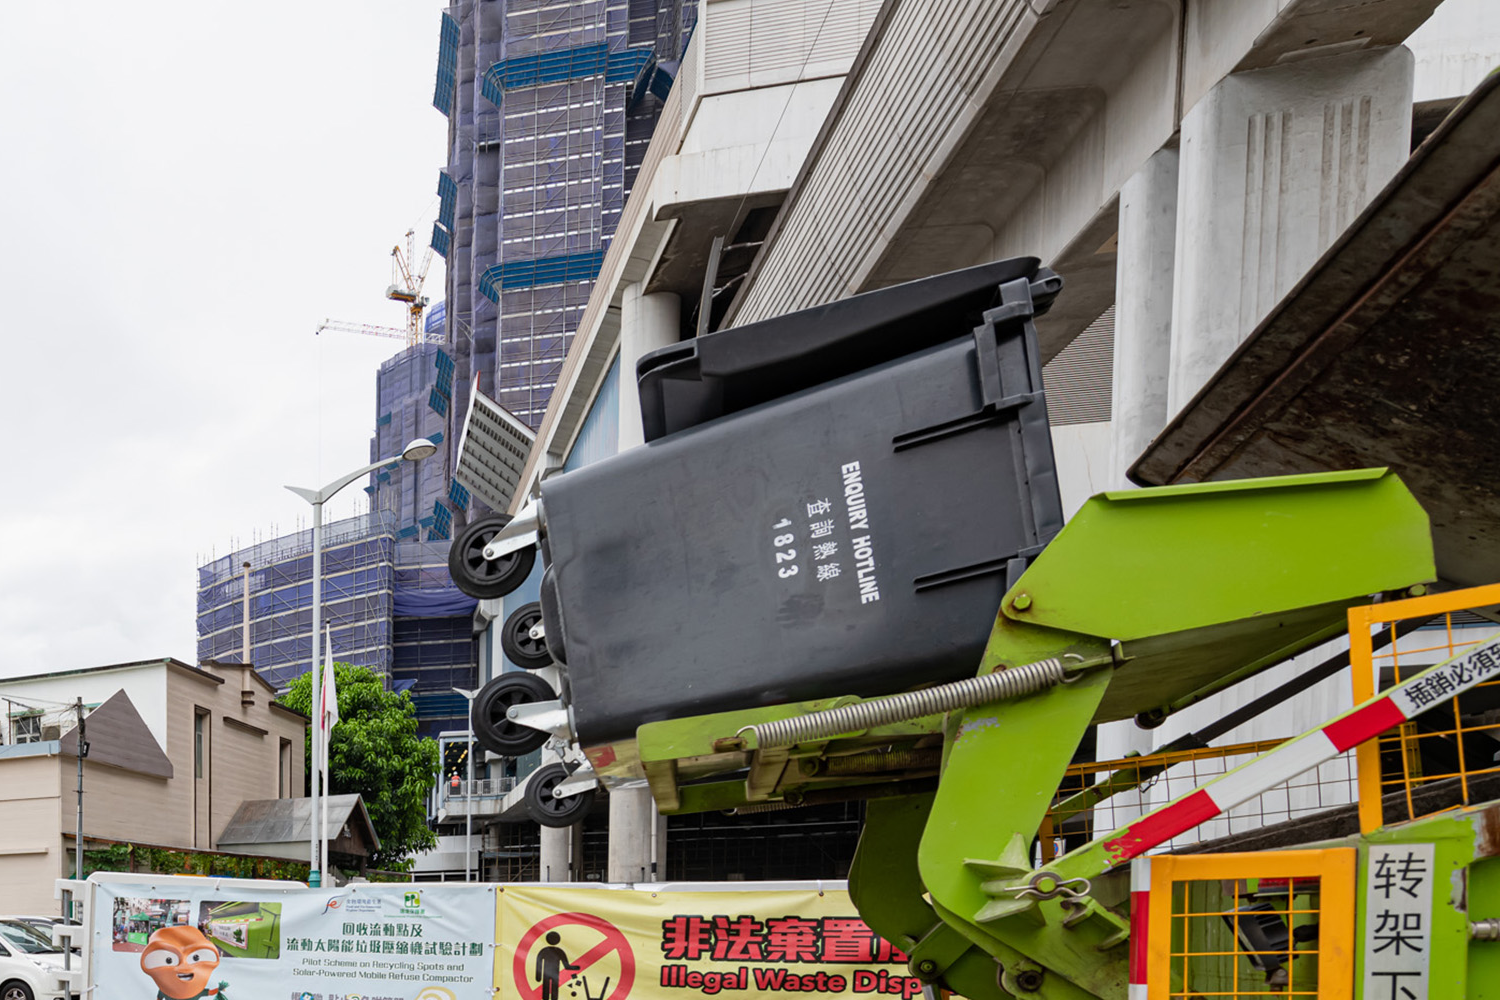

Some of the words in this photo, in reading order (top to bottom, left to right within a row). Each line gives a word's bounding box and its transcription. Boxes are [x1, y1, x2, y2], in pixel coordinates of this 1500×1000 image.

[841, 460, 869, 530] ENQUIRY
[772, 518, 799, 579] 1823
[807, 497, 842, 582] 查詢熱線
[852, 535, 880, 604] HOTLINE
[342, 922, 423, 938] 回收流動點及
[661, 915, 909, 964] 非法棄置
[293, 968, 357, 978] Solar-Powered
[359, 971, 387, 980] Mobile
[389, 972, 421, 981] Refuse
[422, 973, 474, 983] Compactor
[302, 958, 322, 966] Pilot
[323, 959, 357, 968] Scheme
[372, 961, 415, 971] Recycling
[416, 962, 444, 971] Spots
[446, 963, 464, 971] and
[660, 964, 747, 994] Illegal
[751, 969, 847, 994] Waste
[853, 969, 923, 1000] Disp
